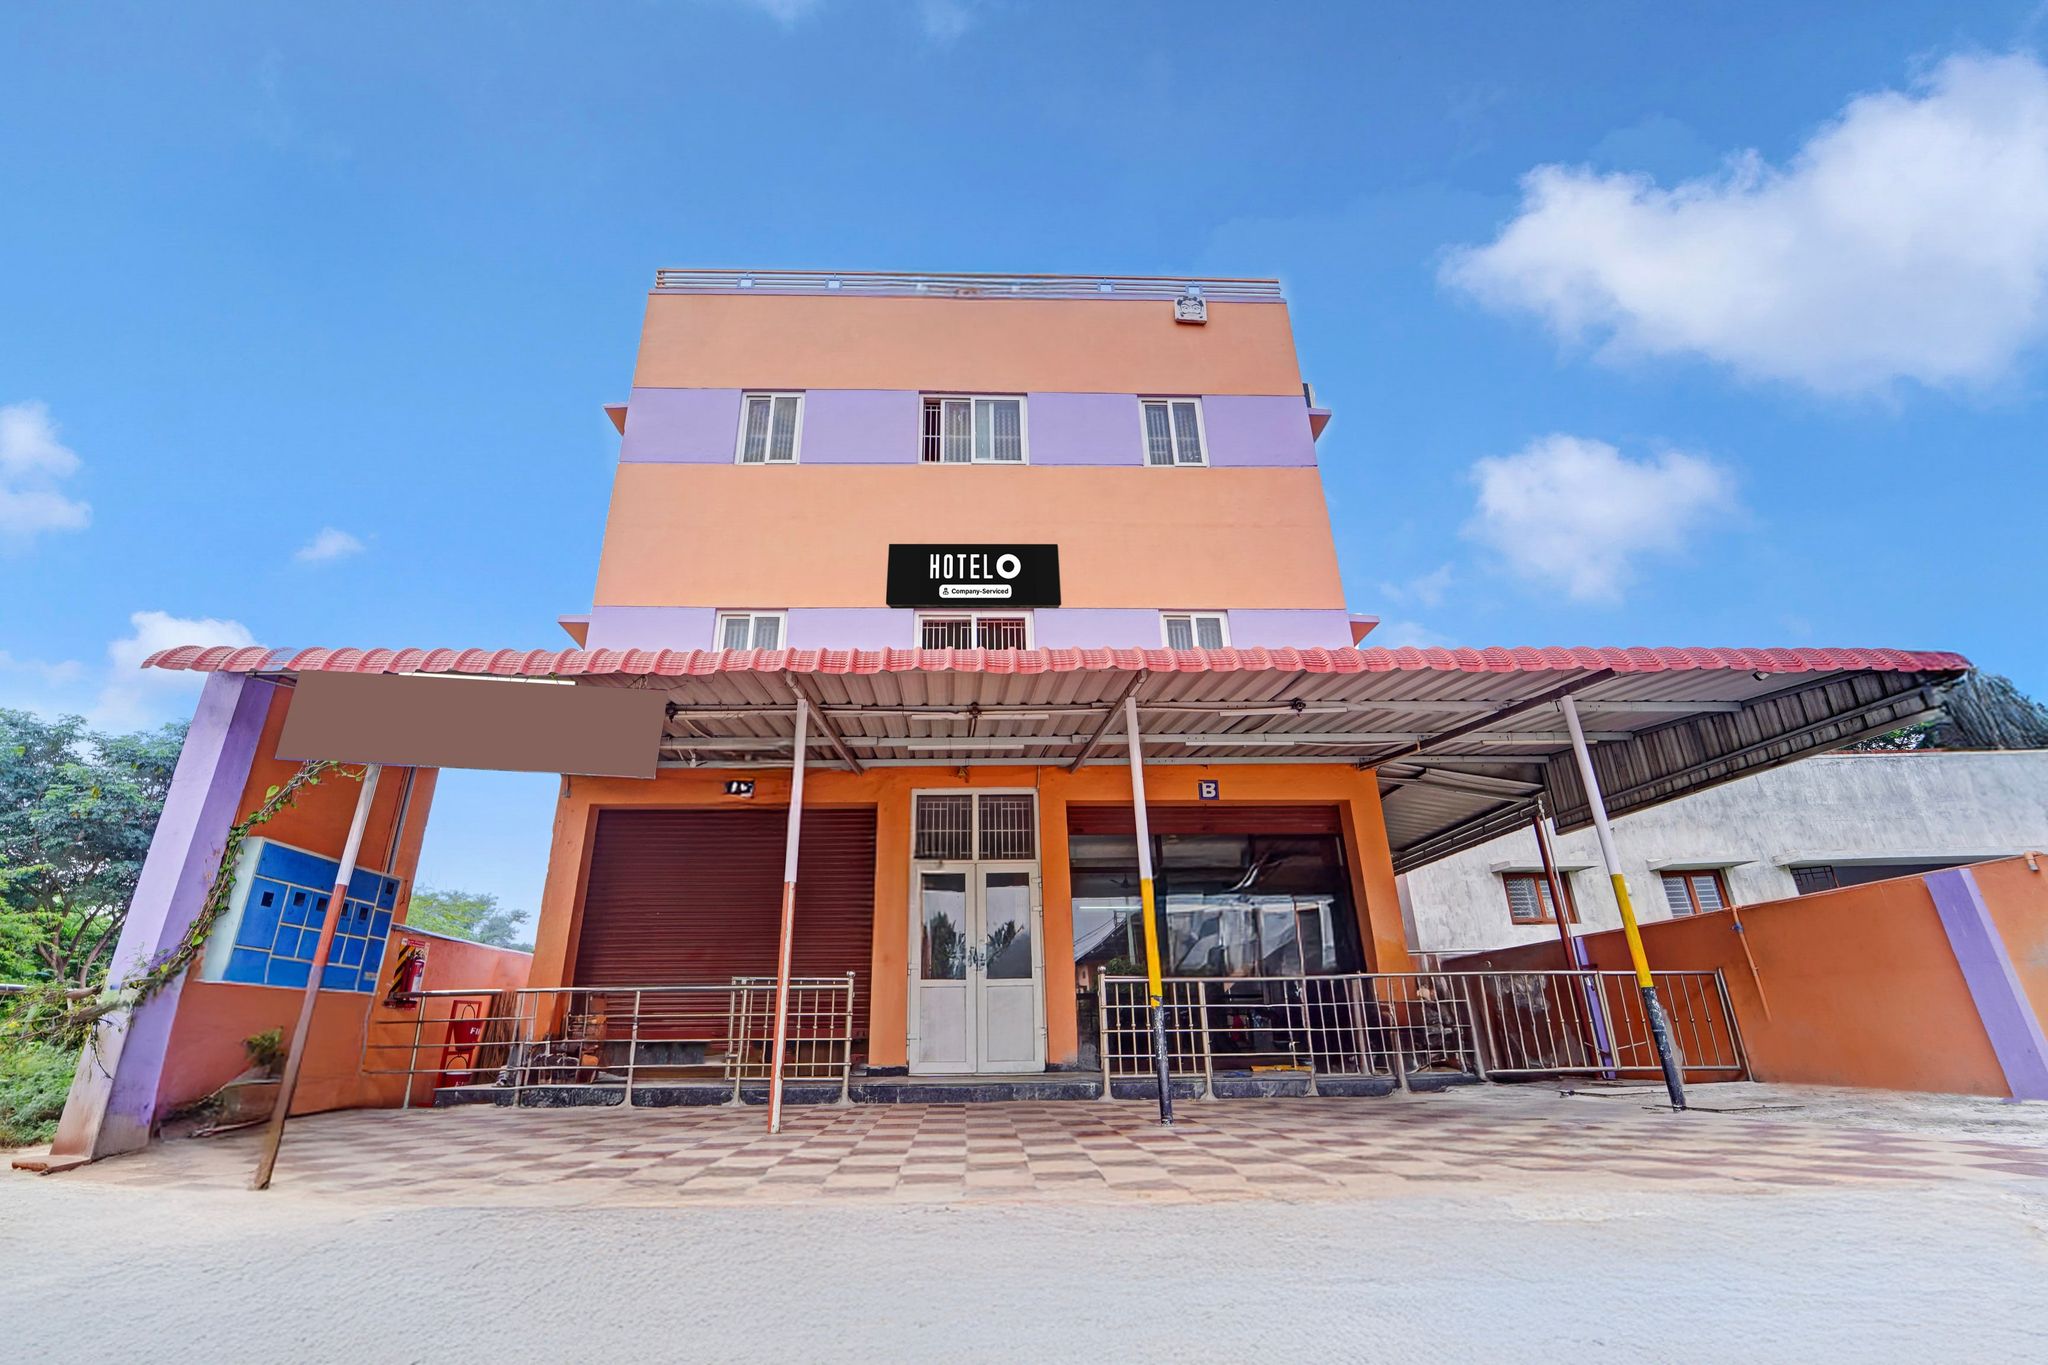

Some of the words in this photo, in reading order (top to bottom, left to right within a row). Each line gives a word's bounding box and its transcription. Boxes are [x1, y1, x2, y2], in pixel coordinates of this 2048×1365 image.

[929, 553, 994, 580] HOTEL
[951, 587, 1009, 596] Company-Serviced
[1202, 782, 1216, 798] B
